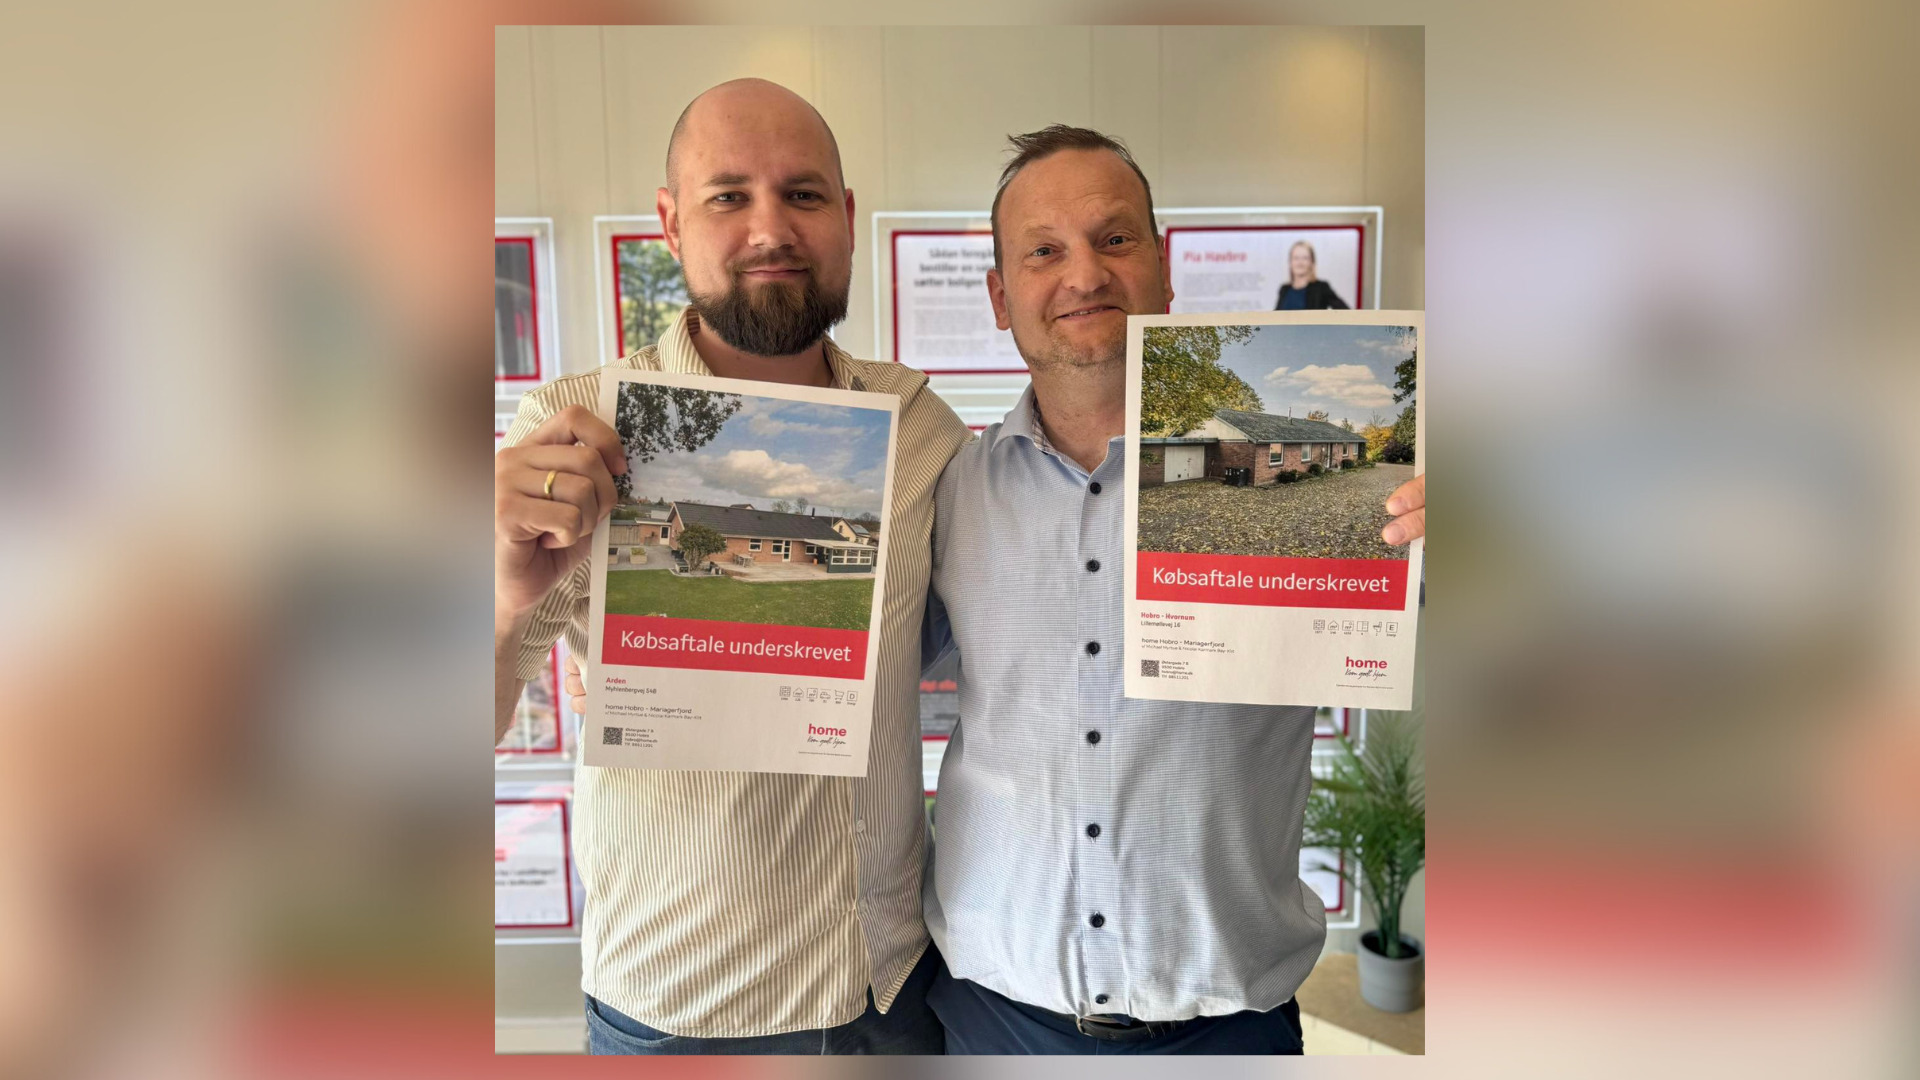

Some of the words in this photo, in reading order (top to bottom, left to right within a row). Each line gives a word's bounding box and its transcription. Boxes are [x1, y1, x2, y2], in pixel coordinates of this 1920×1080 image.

[1152, 567, 1253, 588] Købsaftale
[1258, 573, 1390, 593] underskrevet
[1165, 613, 1195, 621] Hvornum
[621, 630, 725, 653] Købsaftale
[729, 638, 852, 662] underskrevet
[1183, 640, 1225, 648] Mariagerfjord
[1345, 656, 1388, 669] home
[650, 706, 693, 715] Mariagerfjord
[808, 723, 847, 737] home
